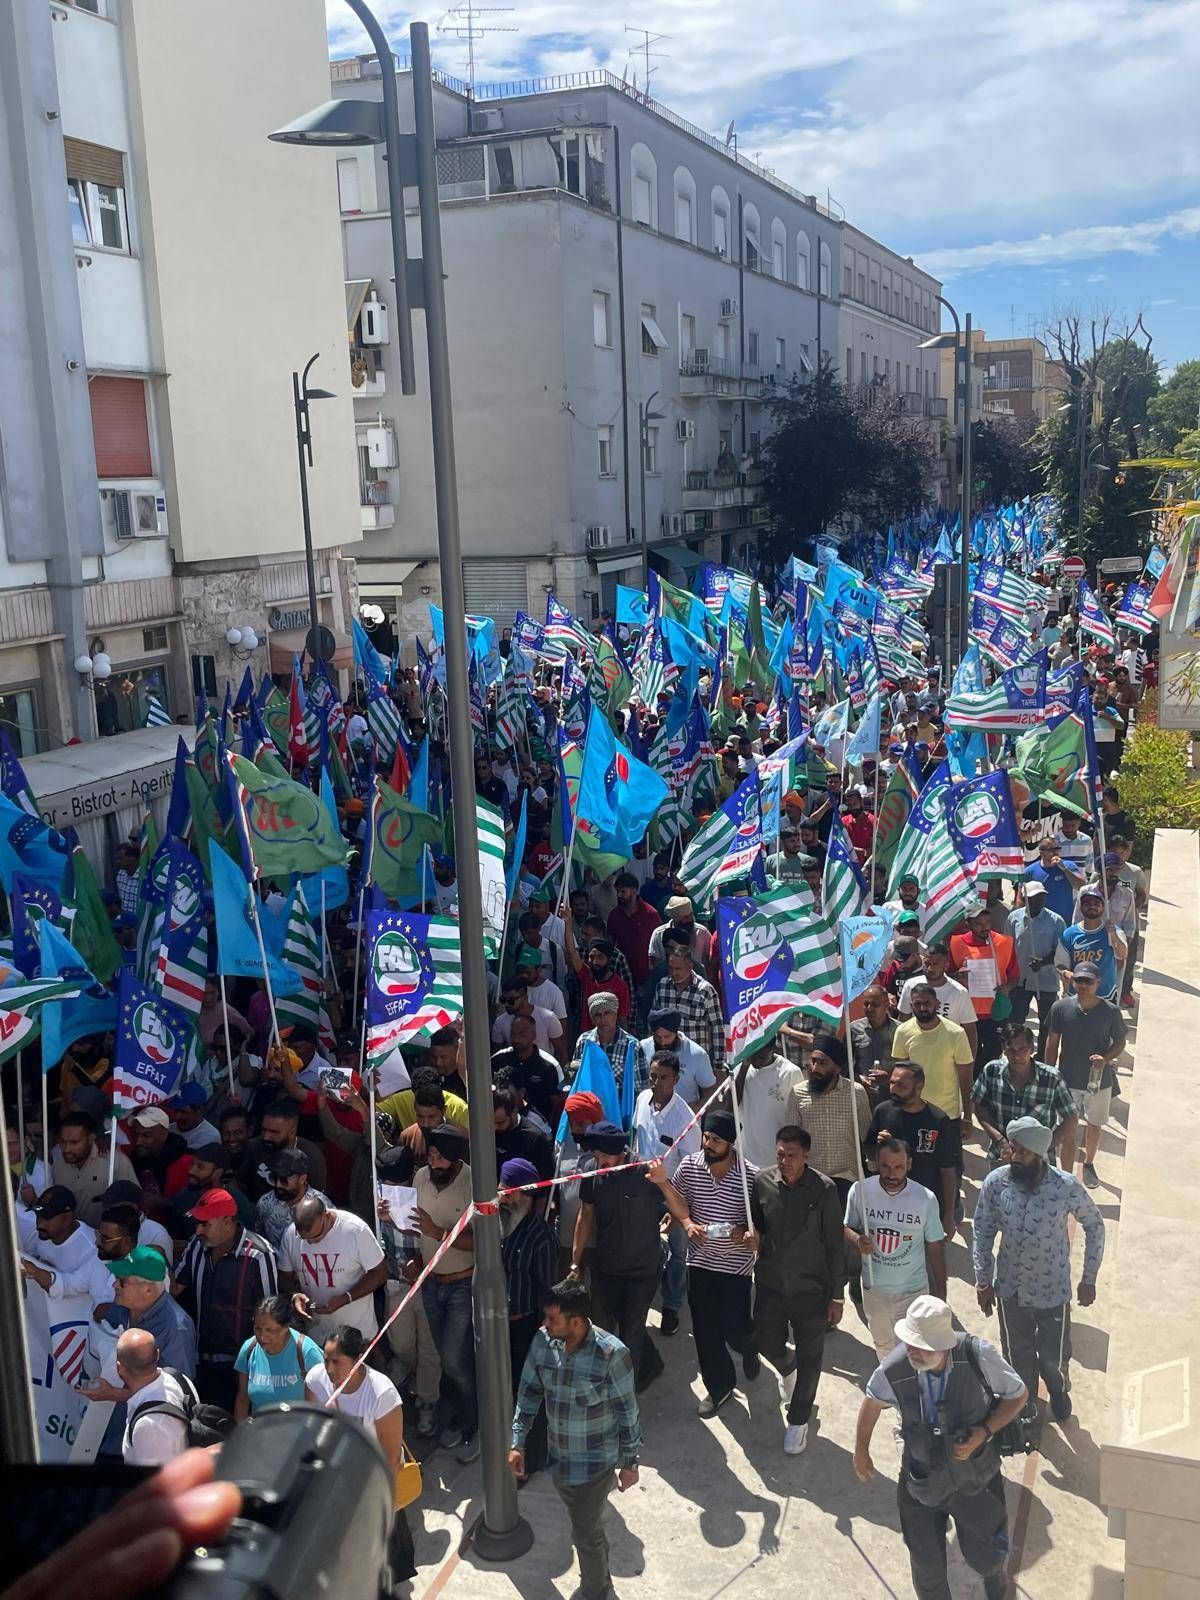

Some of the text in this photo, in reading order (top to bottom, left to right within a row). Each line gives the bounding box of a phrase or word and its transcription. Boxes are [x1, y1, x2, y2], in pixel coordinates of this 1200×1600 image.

[849, 588, 869, 606] UIL
[71, 786, 118, 818] Bistrot
[738, 922, 777, 955] FAI
[136, 1061, 167, 1086] EFFAT
[897, 1211, 921, 1225] USA
[301, 1252, 341, 1289] NY
